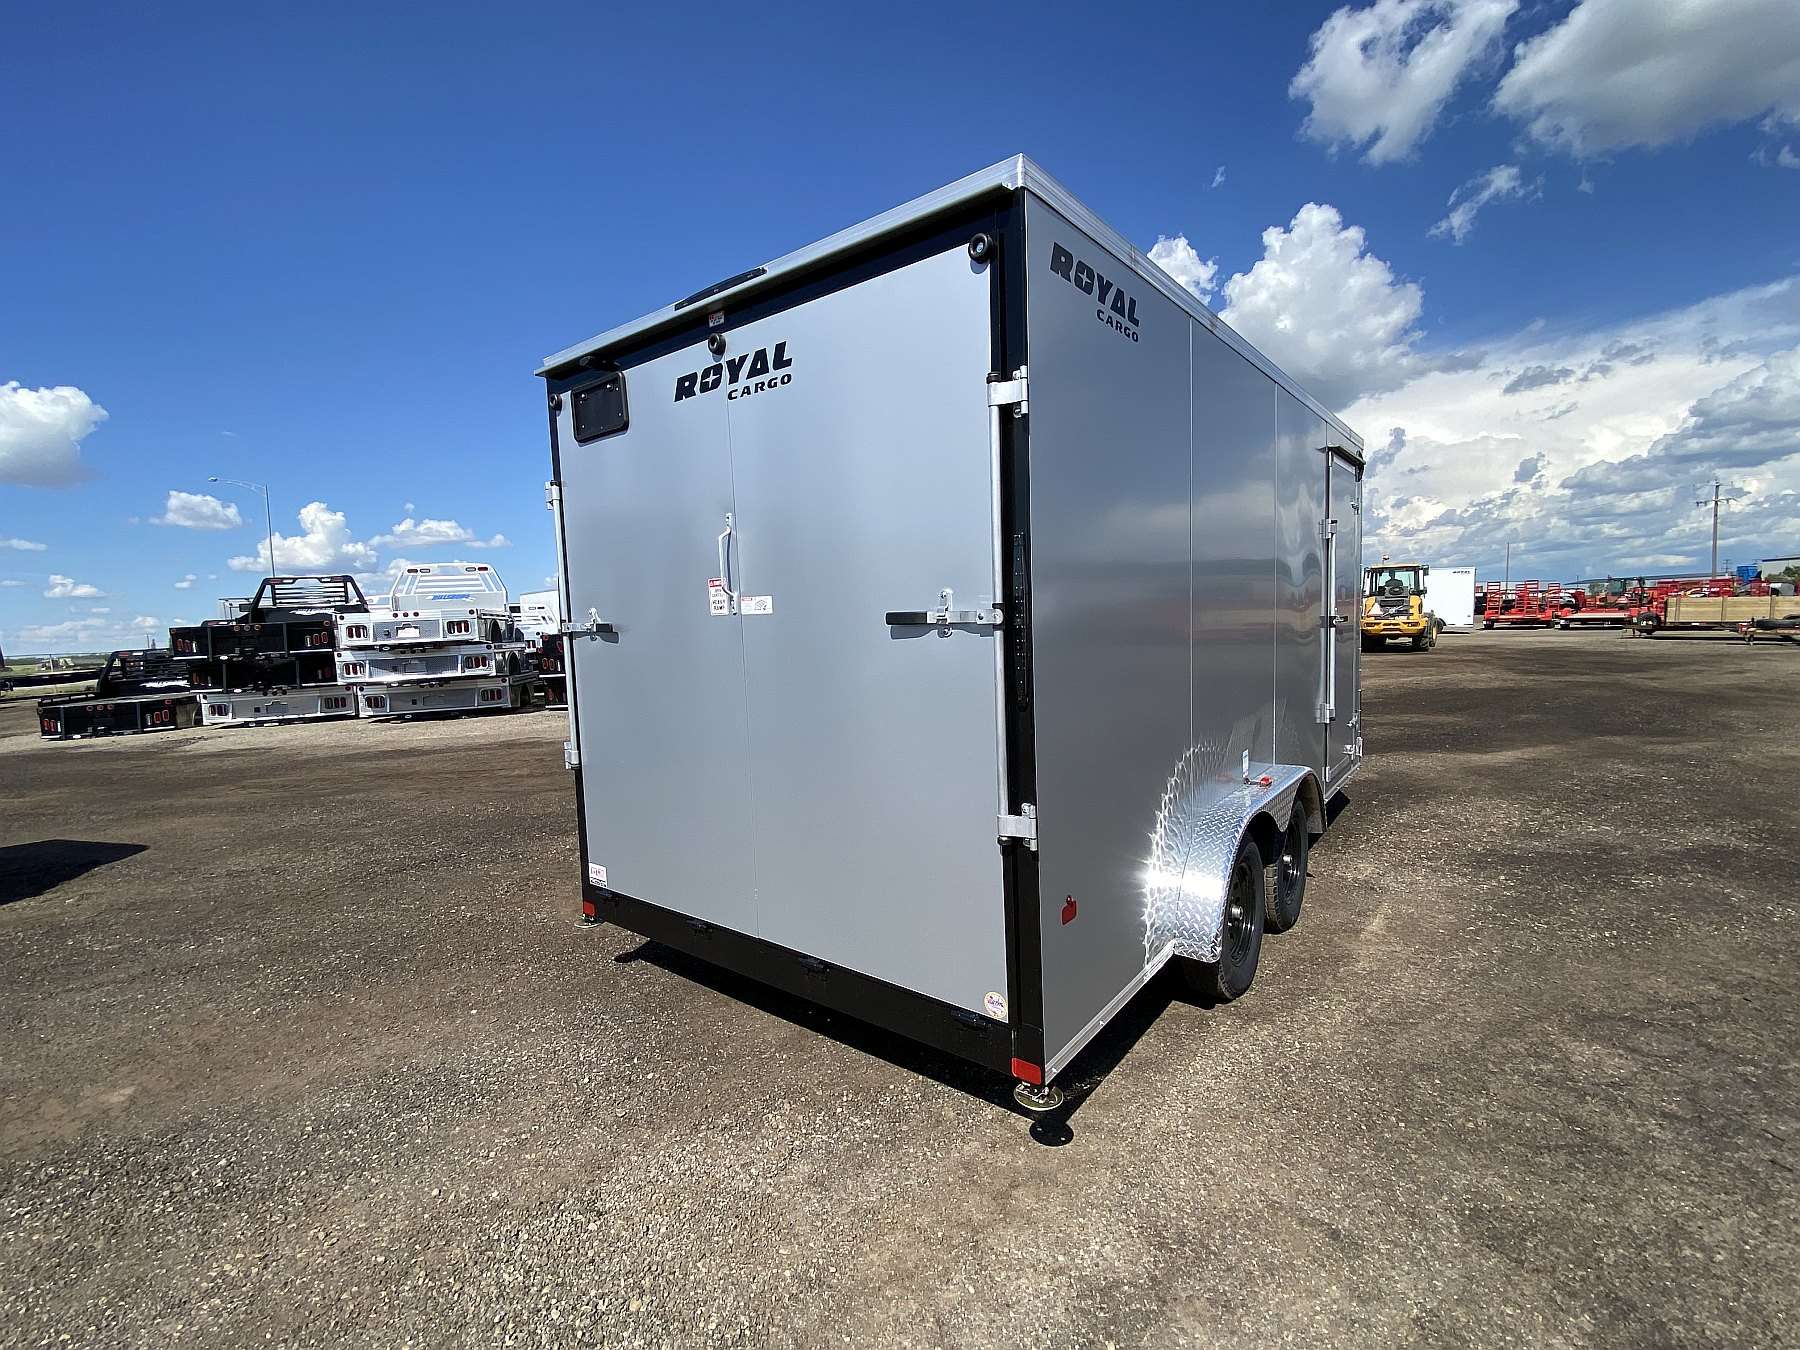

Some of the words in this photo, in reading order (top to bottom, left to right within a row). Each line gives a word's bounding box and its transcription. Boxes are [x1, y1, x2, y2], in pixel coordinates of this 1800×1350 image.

[1049, 241, 1140, 328] ROYAL
[1096, 308, 1139, 343] CARGO
[673, 340, 793, 402] ROYAL
[727, 373, 792, 401] CARGO
